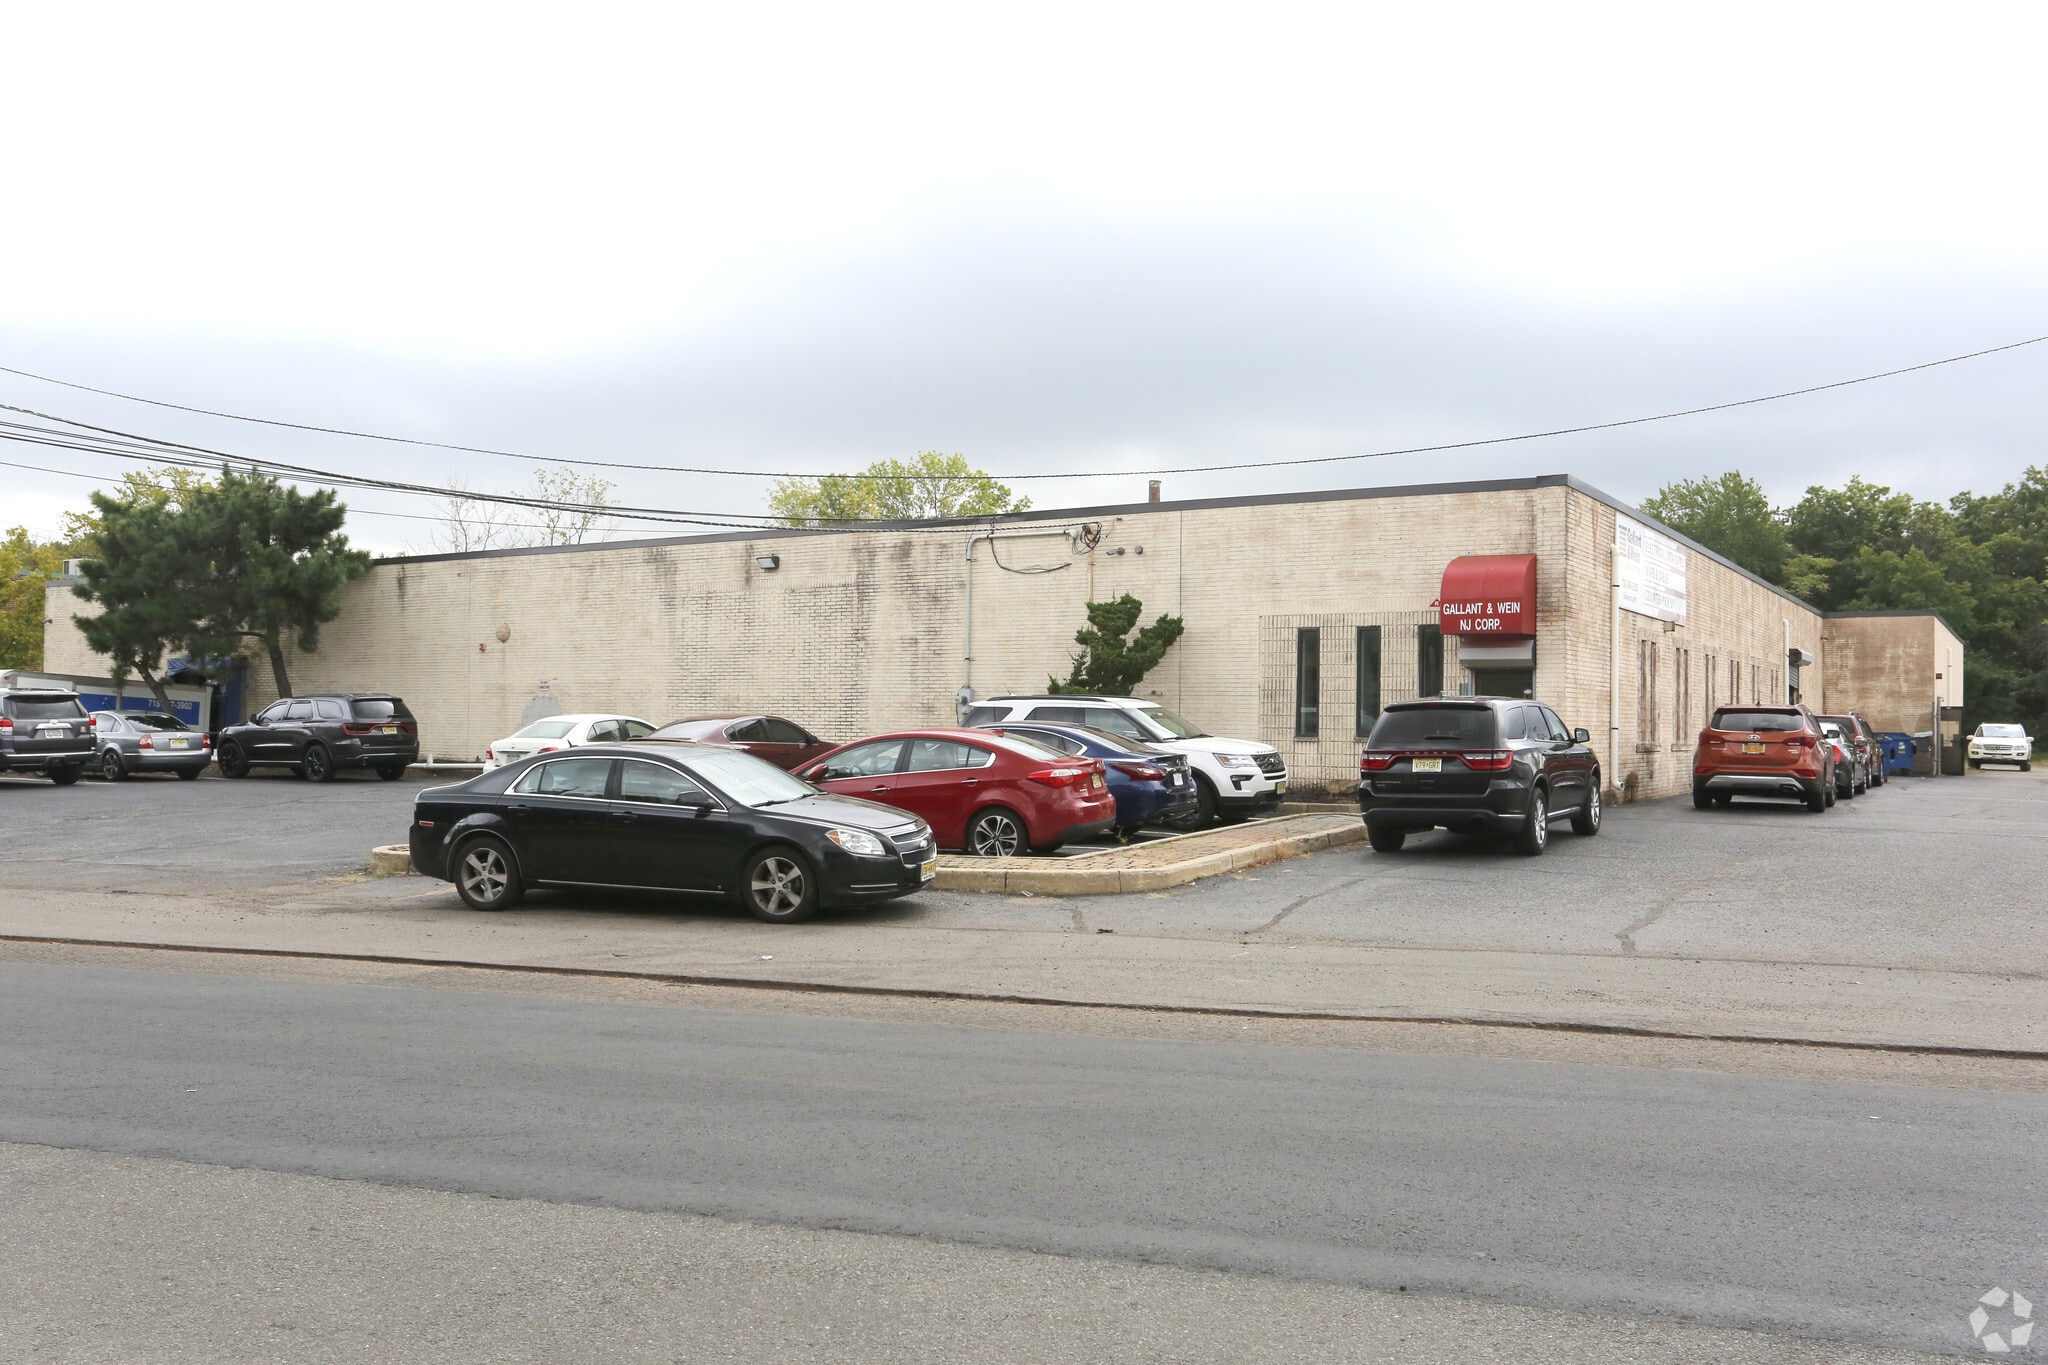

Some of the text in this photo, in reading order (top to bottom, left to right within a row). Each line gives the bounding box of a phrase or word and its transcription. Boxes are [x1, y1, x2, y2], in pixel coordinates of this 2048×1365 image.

[1443, 601, 1520, 615] GALLANT & WEIN
[1460, 618, 1502, 631] NJ CORP.
